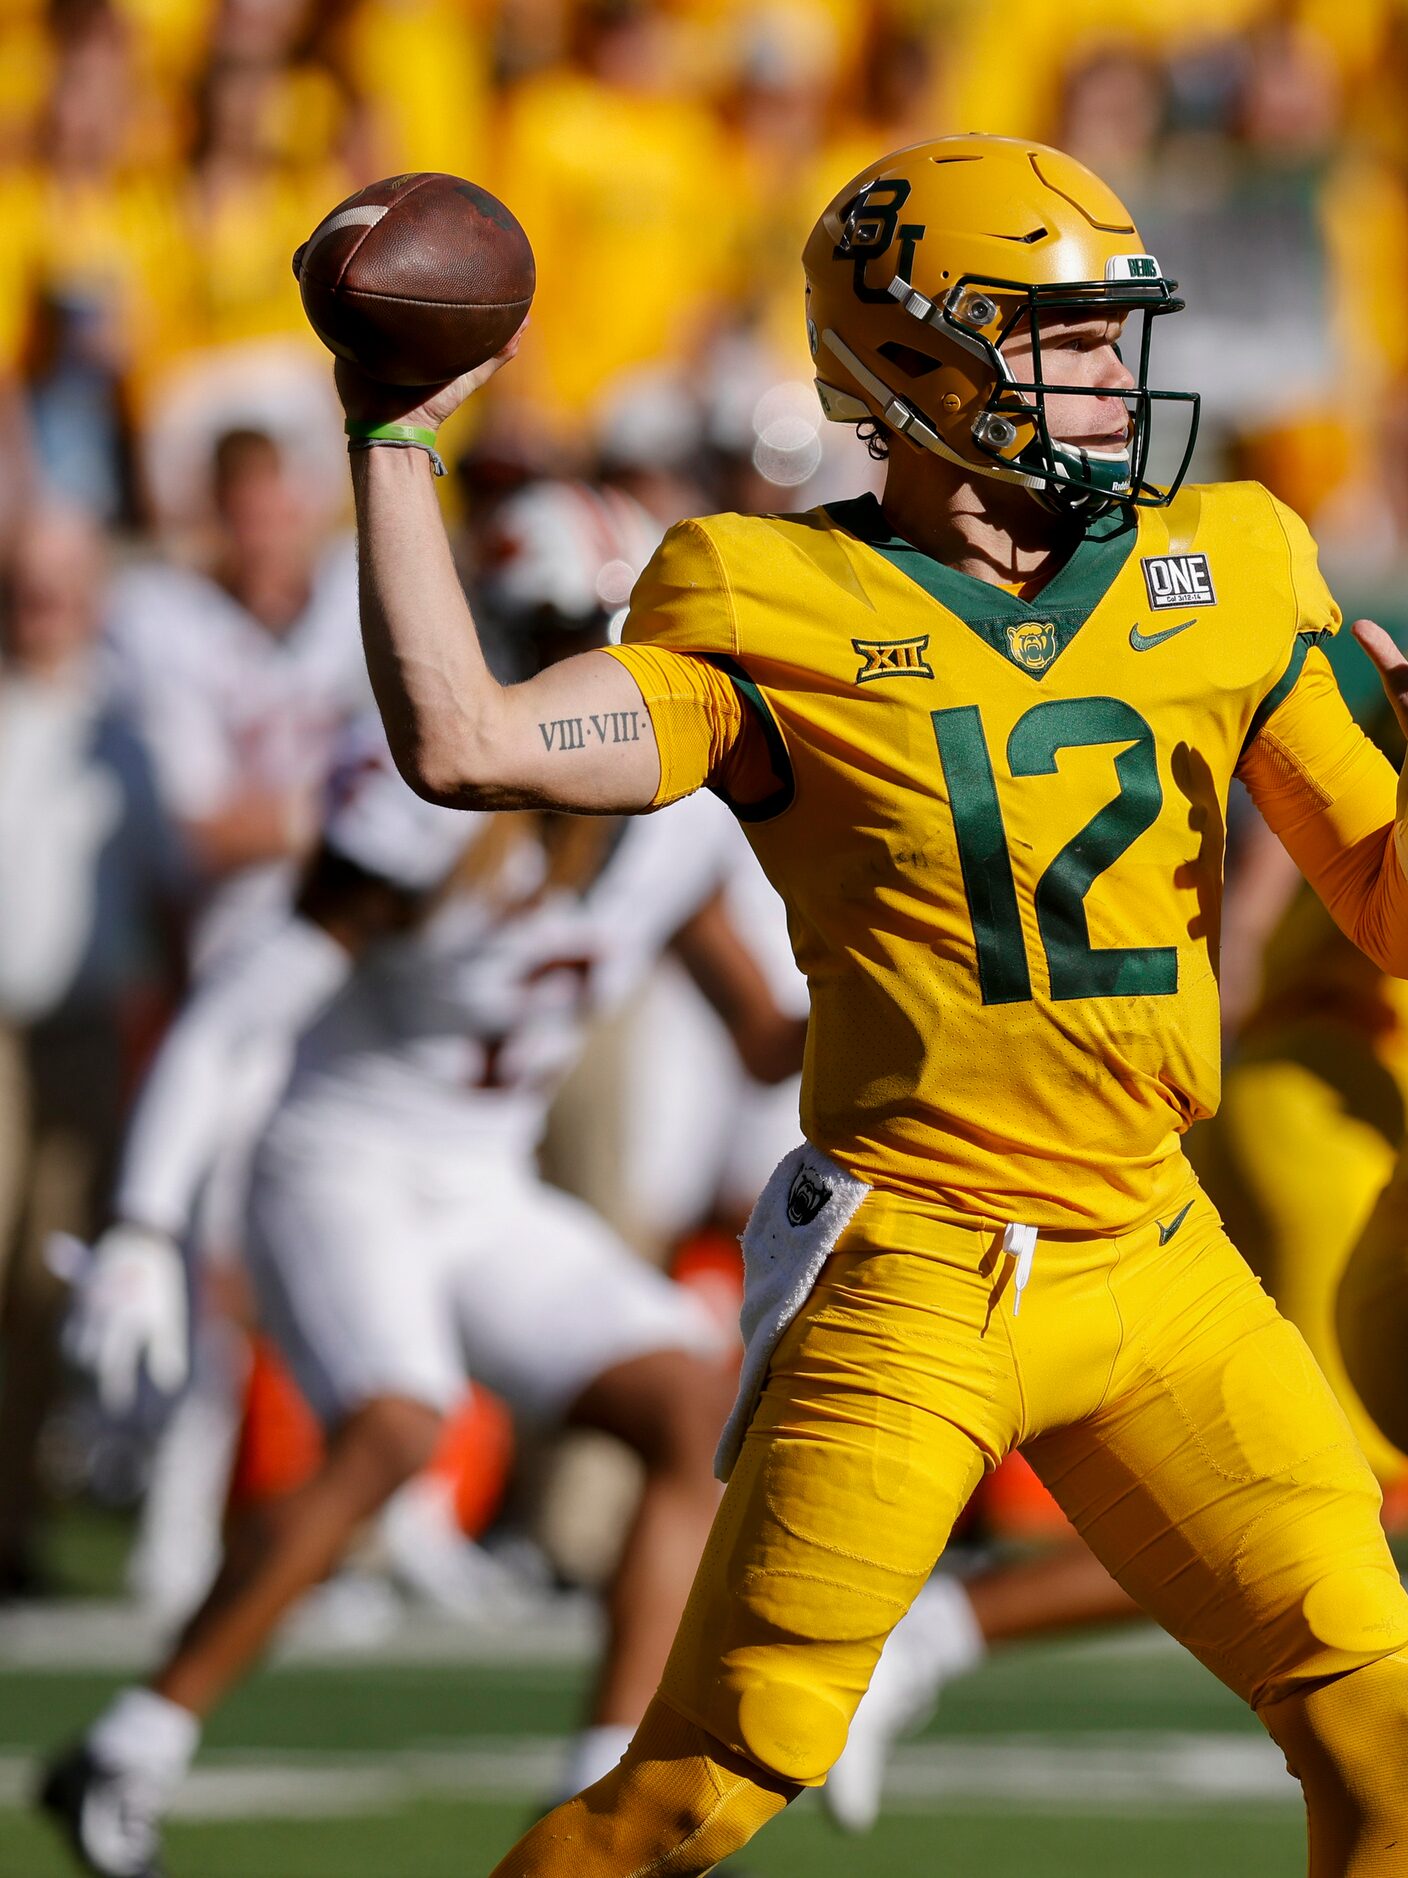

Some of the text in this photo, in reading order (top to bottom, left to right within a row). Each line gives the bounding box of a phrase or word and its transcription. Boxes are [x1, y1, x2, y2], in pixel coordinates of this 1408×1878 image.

[832, 177, 927, 304] BU
[1149, 556, 1210, 595] ONE
[856, 640, 931, 679] XII
[930, 696, 1178, 1006] 12
